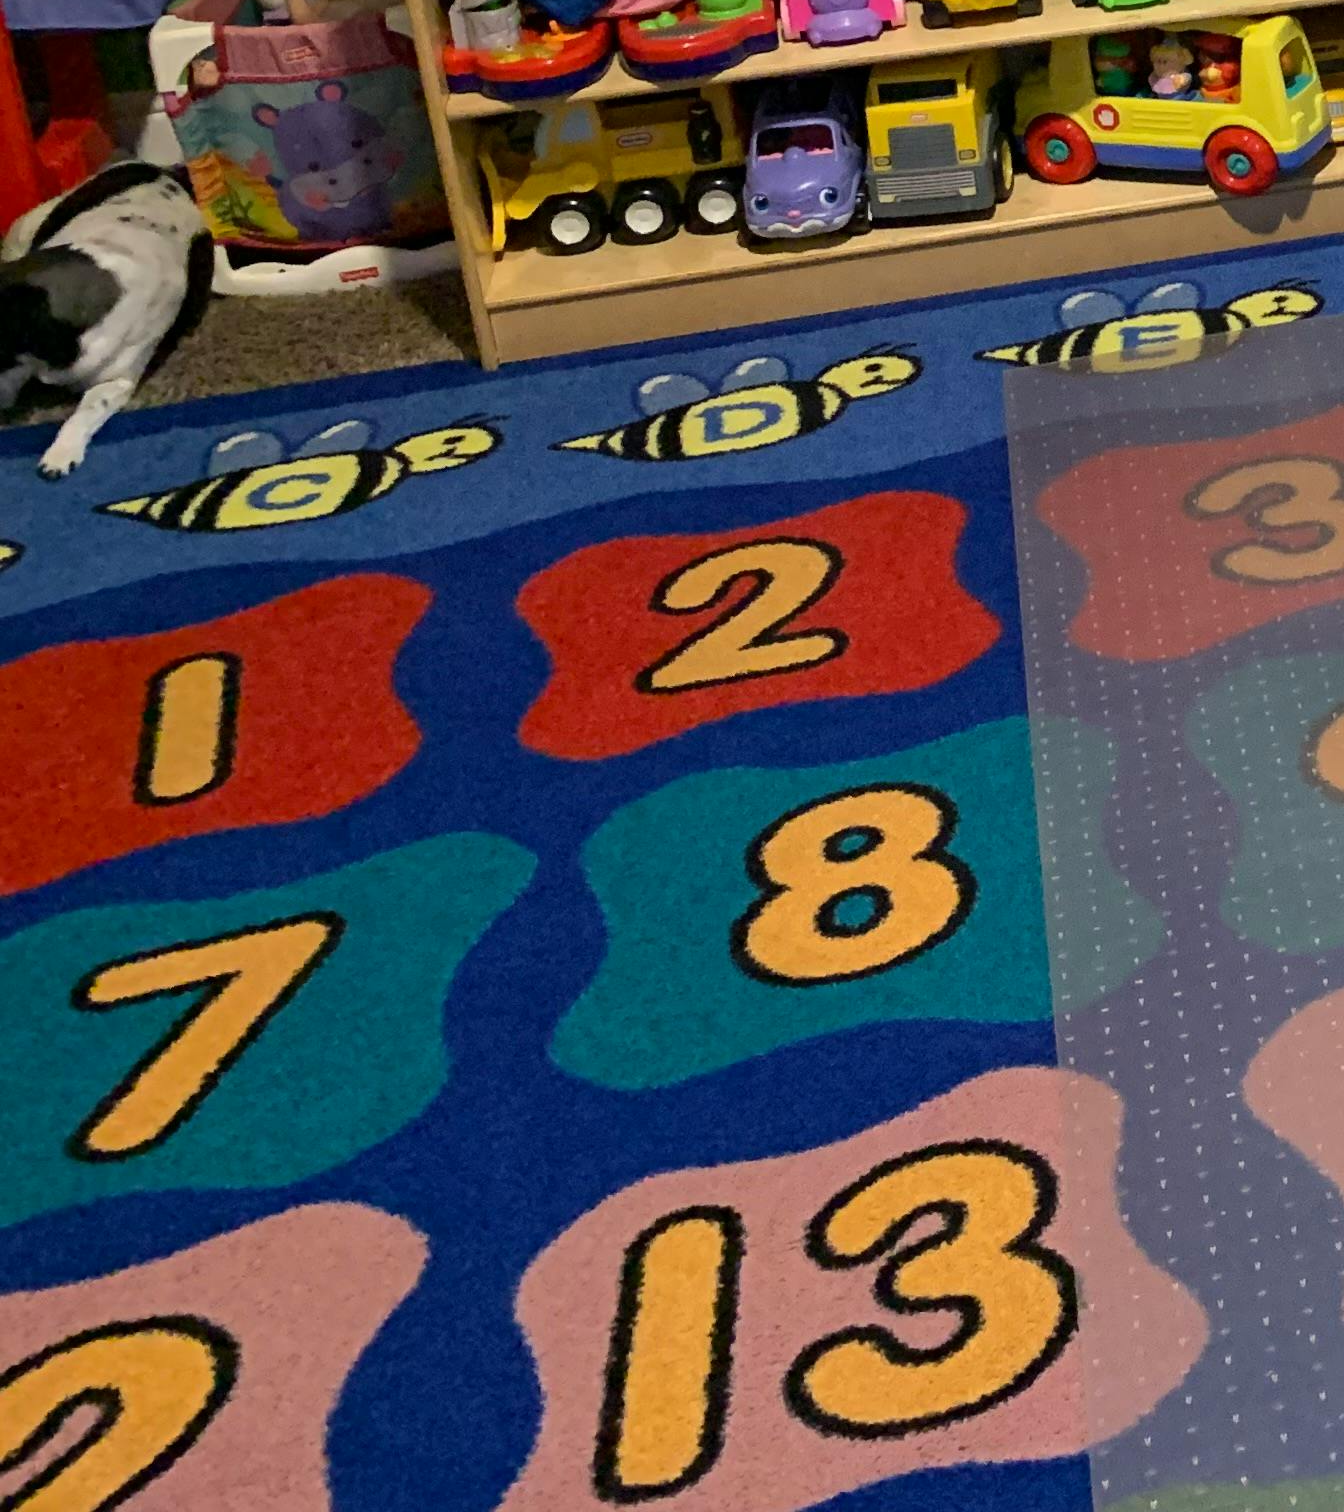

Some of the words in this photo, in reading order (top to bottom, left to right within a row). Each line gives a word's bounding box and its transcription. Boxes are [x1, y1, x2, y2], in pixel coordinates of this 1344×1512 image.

[697, 400, 785, 446] D
[1118, 323, 1181, 367] E
[245, 470, 331, 511] C
[634, 535, 849, 694] 2
[131, 651, 242, 806] 1
[730, 782, 978, 987] 8
[66, 911, 347, 1164] 7
[594, 1139, 1079, 1505] 13
